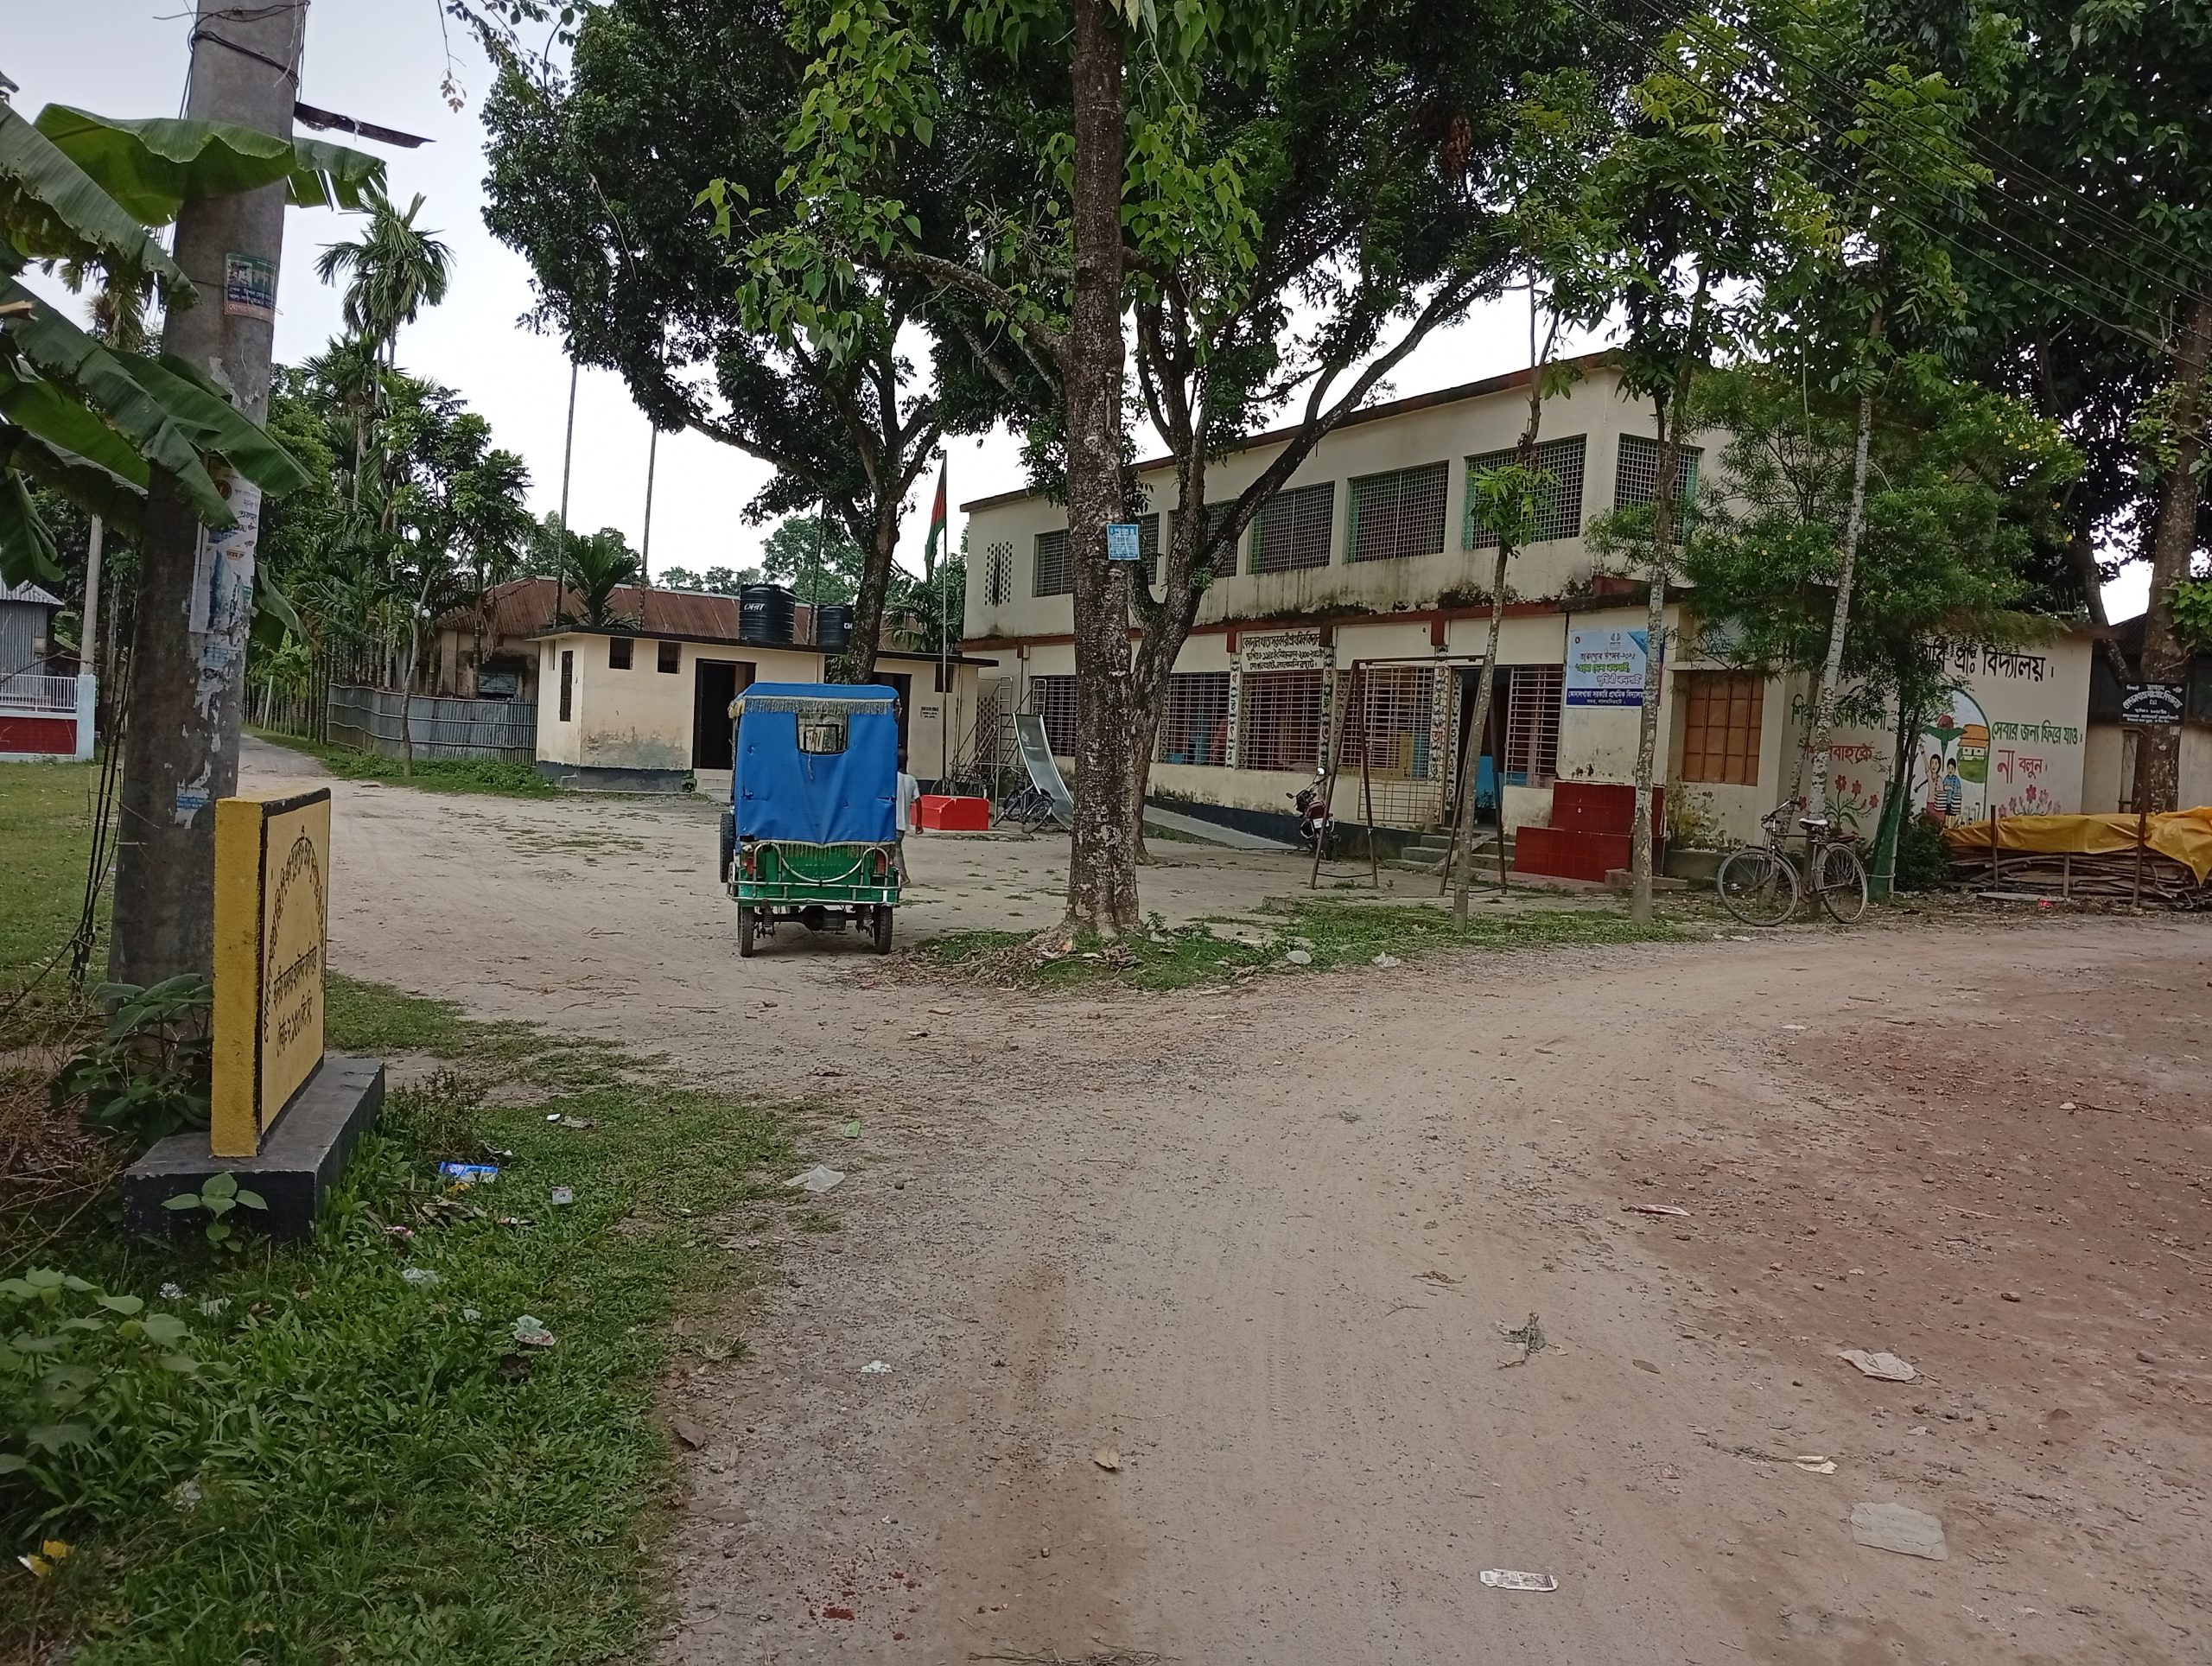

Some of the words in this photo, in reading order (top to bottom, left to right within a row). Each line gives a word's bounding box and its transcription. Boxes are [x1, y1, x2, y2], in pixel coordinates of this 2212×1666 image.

[1992, 721, 2019, 741] সেবার
[2020, 723, 2040, 744] জন্য
[2041, 720, 2063, 744] ফিরে
[1997, 749, 2016, 785] না
